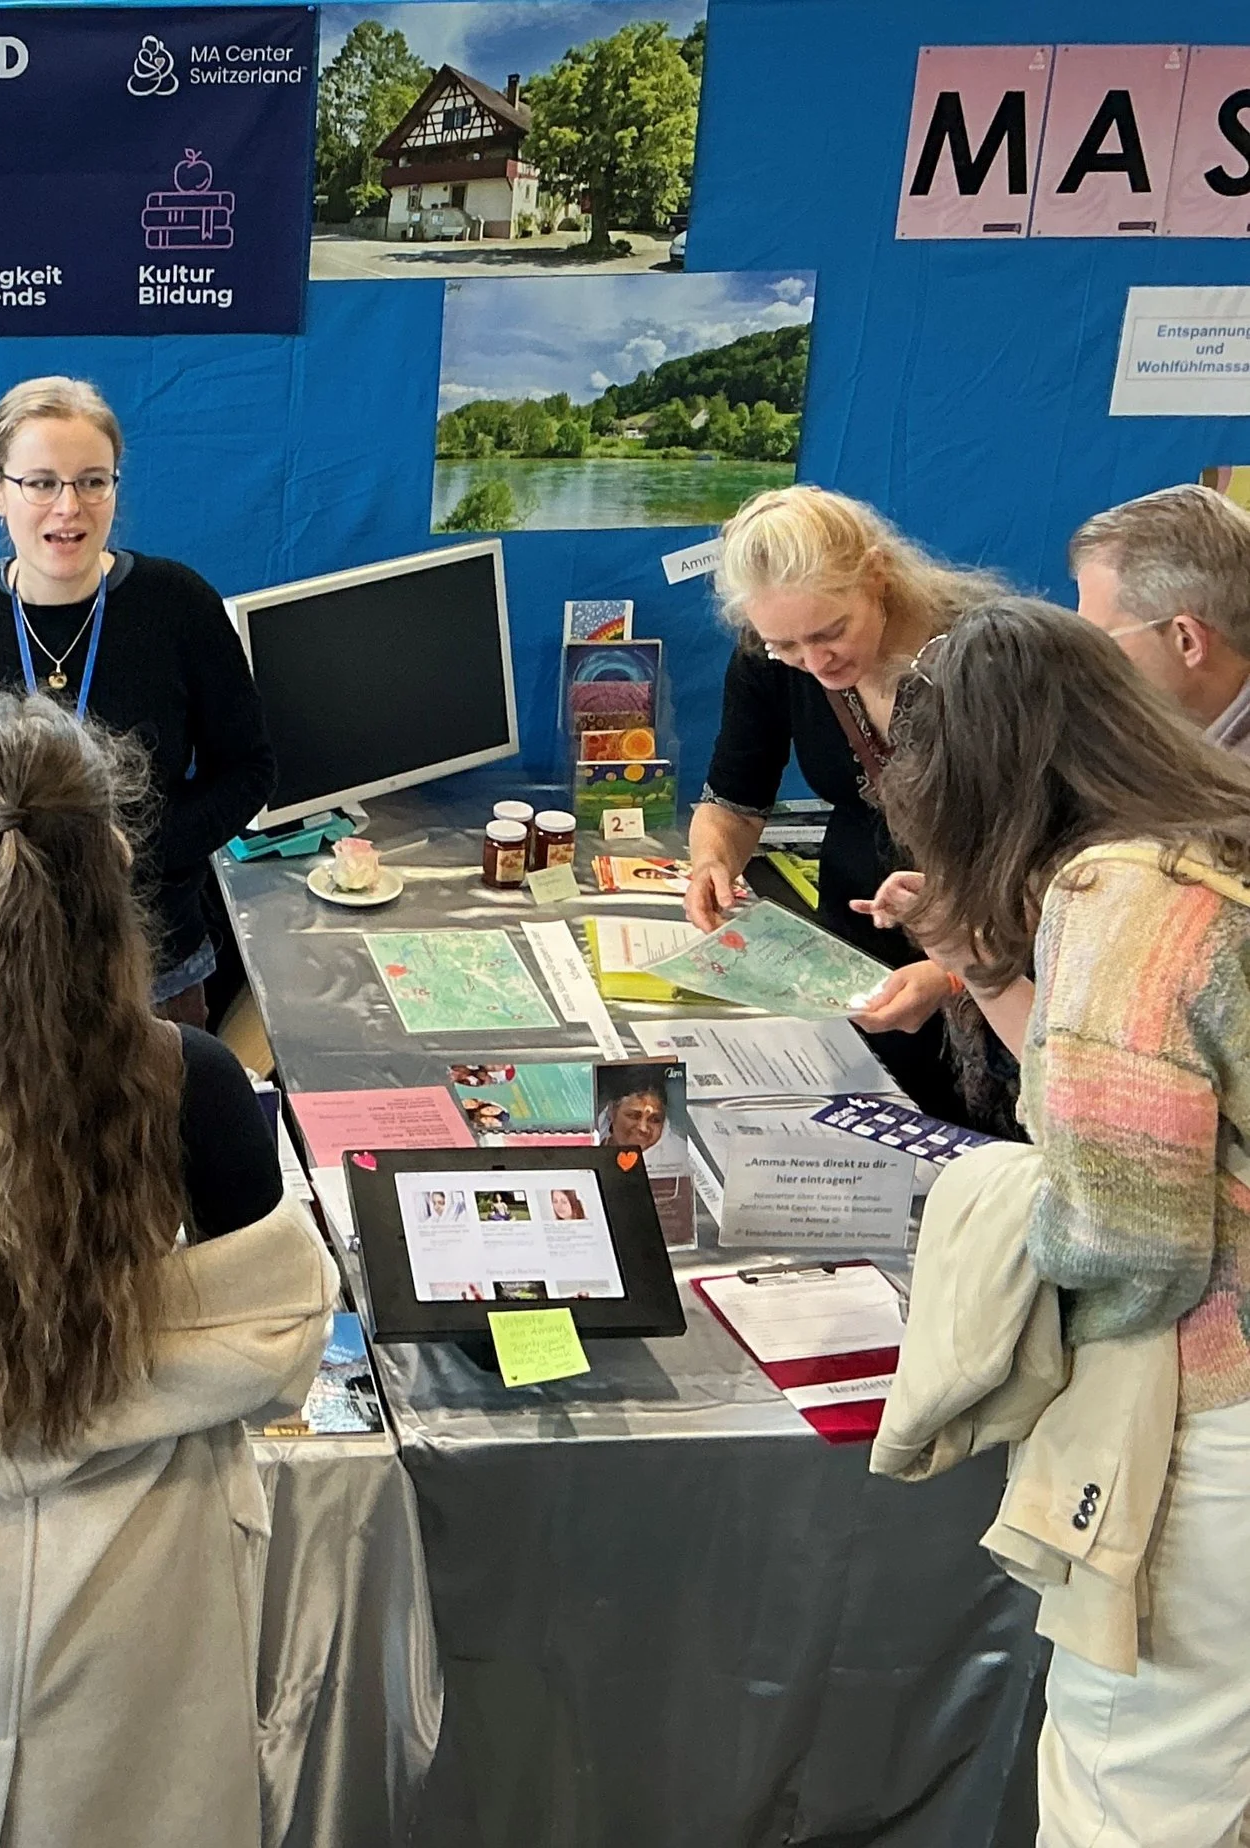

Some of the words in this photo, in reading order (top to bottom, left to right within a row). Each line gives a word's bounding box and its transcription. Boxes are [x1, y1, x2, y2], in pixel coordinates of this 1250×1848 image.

[191, 46, 220, 62] MA
[225, 45, 293, 62] Center
[138, 264, 215, 286] Kultur
[139, 283, 233, 308] Bildung
[1196, 343, 1225, 355] und
[823, 1157, 855, 1169] direkt
[857, 1160, 870, 1169] zu
[872, 1158, 888, 1169] dir
[776, 1174, 798, 1184] hier
